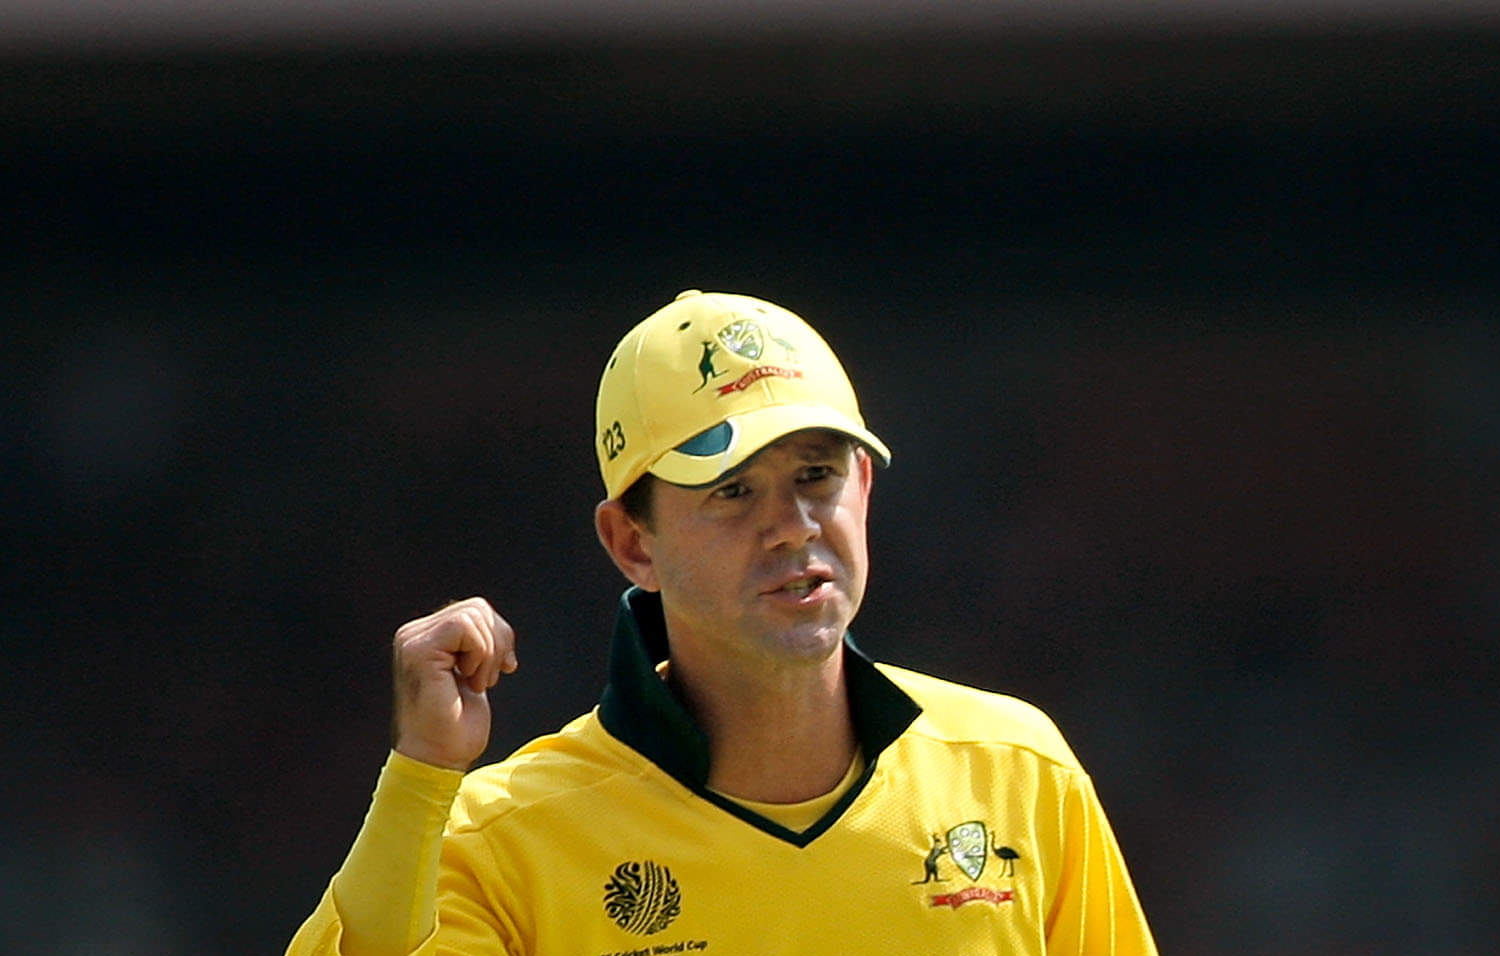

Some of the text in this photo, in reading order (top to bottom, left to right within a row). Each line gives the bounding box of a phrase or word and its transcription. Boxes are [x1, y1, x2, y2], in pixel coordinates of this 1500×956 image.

[602, 421, 626, 461] 123
[652, 941, 685, 956] World
[687, 940, 708, 951] Cup
